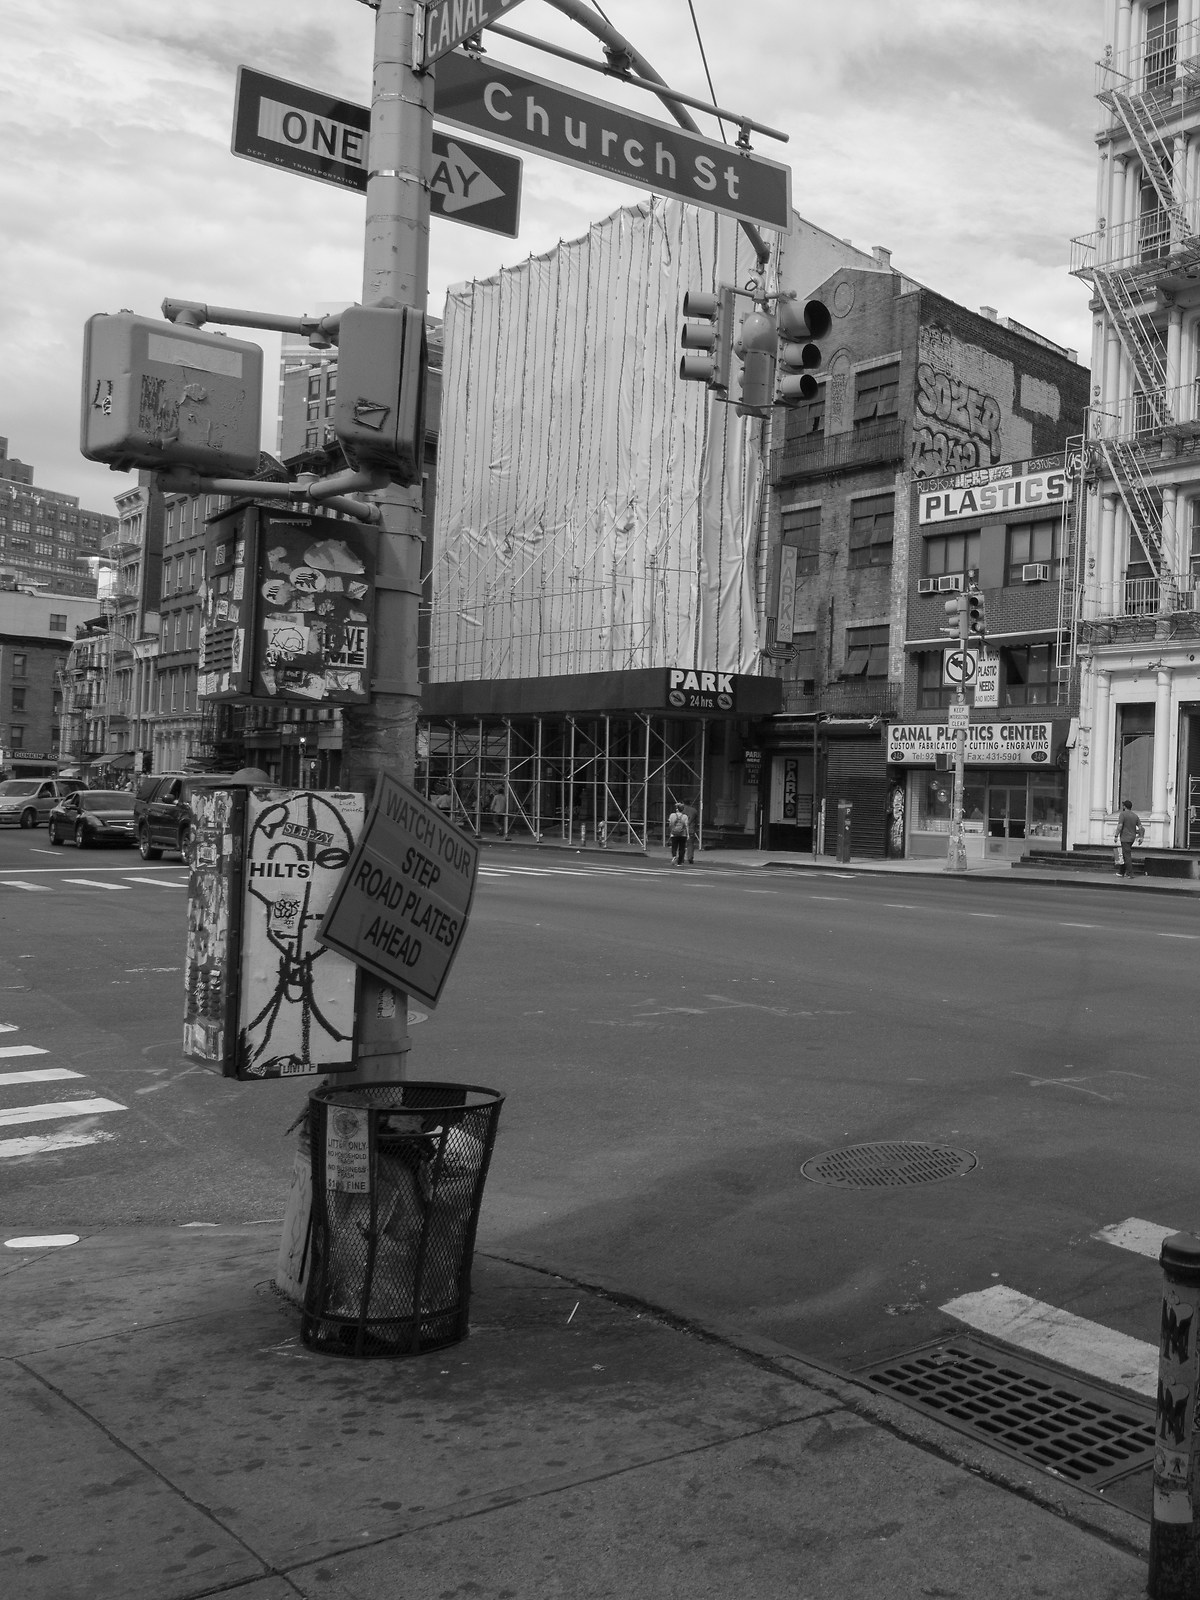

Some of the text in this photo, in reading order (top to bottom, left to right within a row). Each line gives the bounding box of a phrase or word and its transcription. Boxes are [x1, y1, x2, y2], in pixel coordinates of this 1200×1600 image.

[427, 0, 489, 58] CANAL
[282, 111, 481, 198] ONE AY
[483, 82, 740, 200] Church St
[247, 148, 267, 158] DEPT
[292, 162, 359, 187] TRANSPORTATION
[925, 474, 1065, 519] PLASTICS
[780, 548, 796, 621] PARK
[780, 623, 791, 632] 24
[670, 670, 734, 694] PARK
[978, 665, 997, 677] PLASTIC
[979, 681, 995, 692] NEEDS
[689, 695, 700, 707] 24
[890, 741, 1049, 750] CUSTOM FABRICATIO CUTTING ENGRAVING
[893, 727, 932, 741] CANAL
[1000, 725, 1047, 741] CENTER
[785, 760, 797, 804] PARK
[284, 823, 335, 846] SLEEZY
[386, 788, 471, 878] WATCH YOUR
[251, 863, 311, 879] HILTS
[401, 847, 440, 889] STEP
[354, 859, 404, 911] ROAD
[401, 890, 458, 947] PLATES
[364, 915, 422, 968] AHEAD
[347, 1181, 366, 1190] FINE
